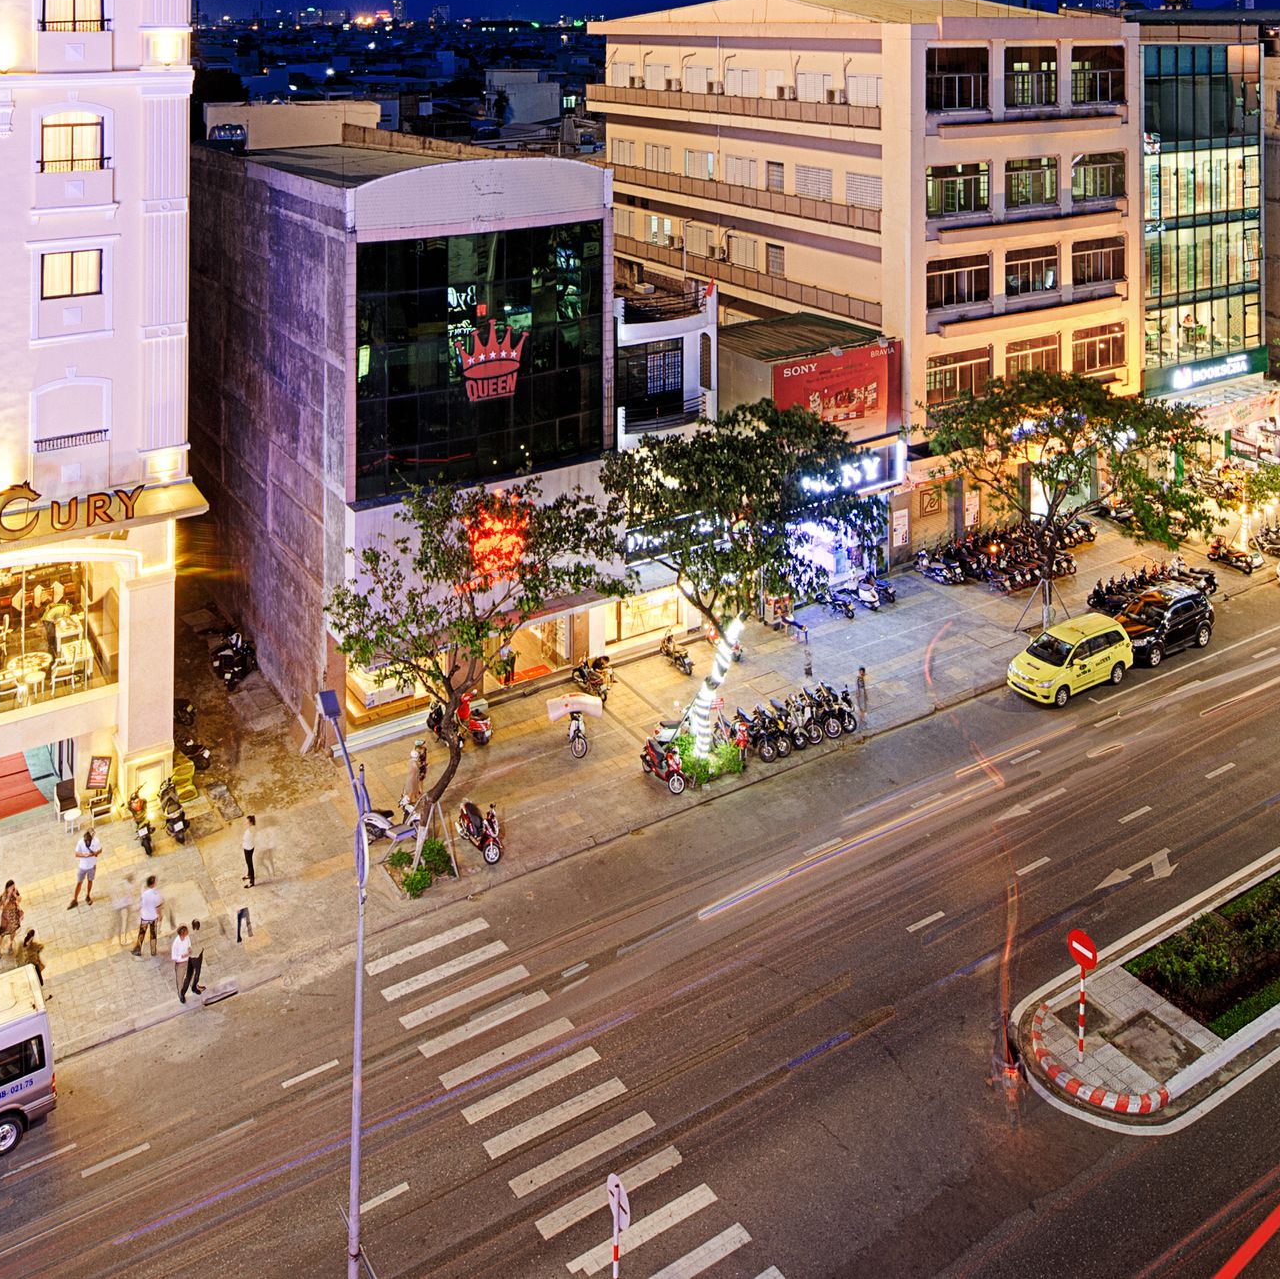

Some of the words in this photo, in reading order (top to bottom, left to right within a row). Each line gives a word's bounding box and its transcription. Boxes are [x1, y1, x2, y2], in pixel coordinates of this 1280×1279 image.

[870, 346, 895, 359] BRAVIA
[783, 362, 818, 378] SONY
[465, 372, 519, 402] QUEEN
